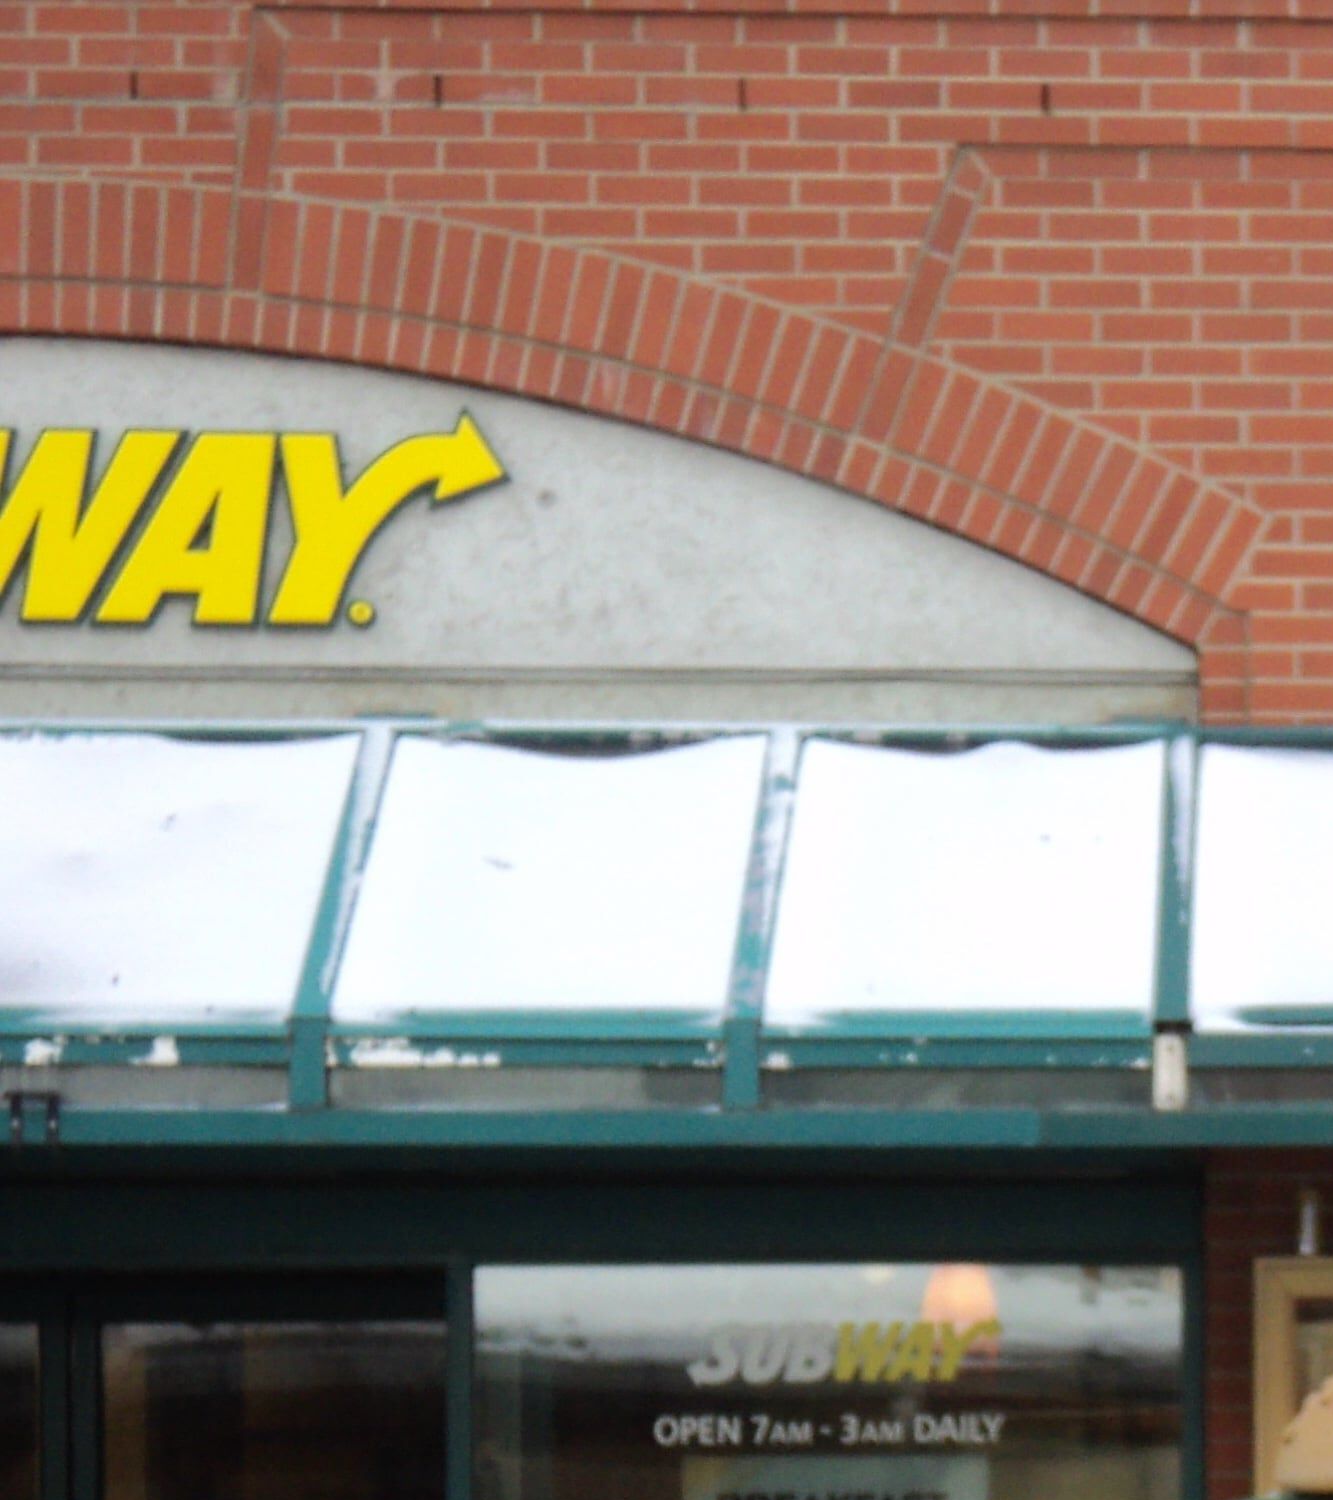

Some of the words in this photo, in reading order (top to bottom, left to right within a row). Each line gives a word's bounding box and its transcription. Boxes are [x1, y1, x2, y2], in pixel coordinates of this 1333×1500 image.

[687, 1319, 1001, 1387] SUBWAY
[653, 1413, 742, 1446] OPEN
[750, 1414, 814, 1445] 7AM
[839, 1413, 905, 1445] 3AM
[913, 1413, 1005, 1444] DAILY
